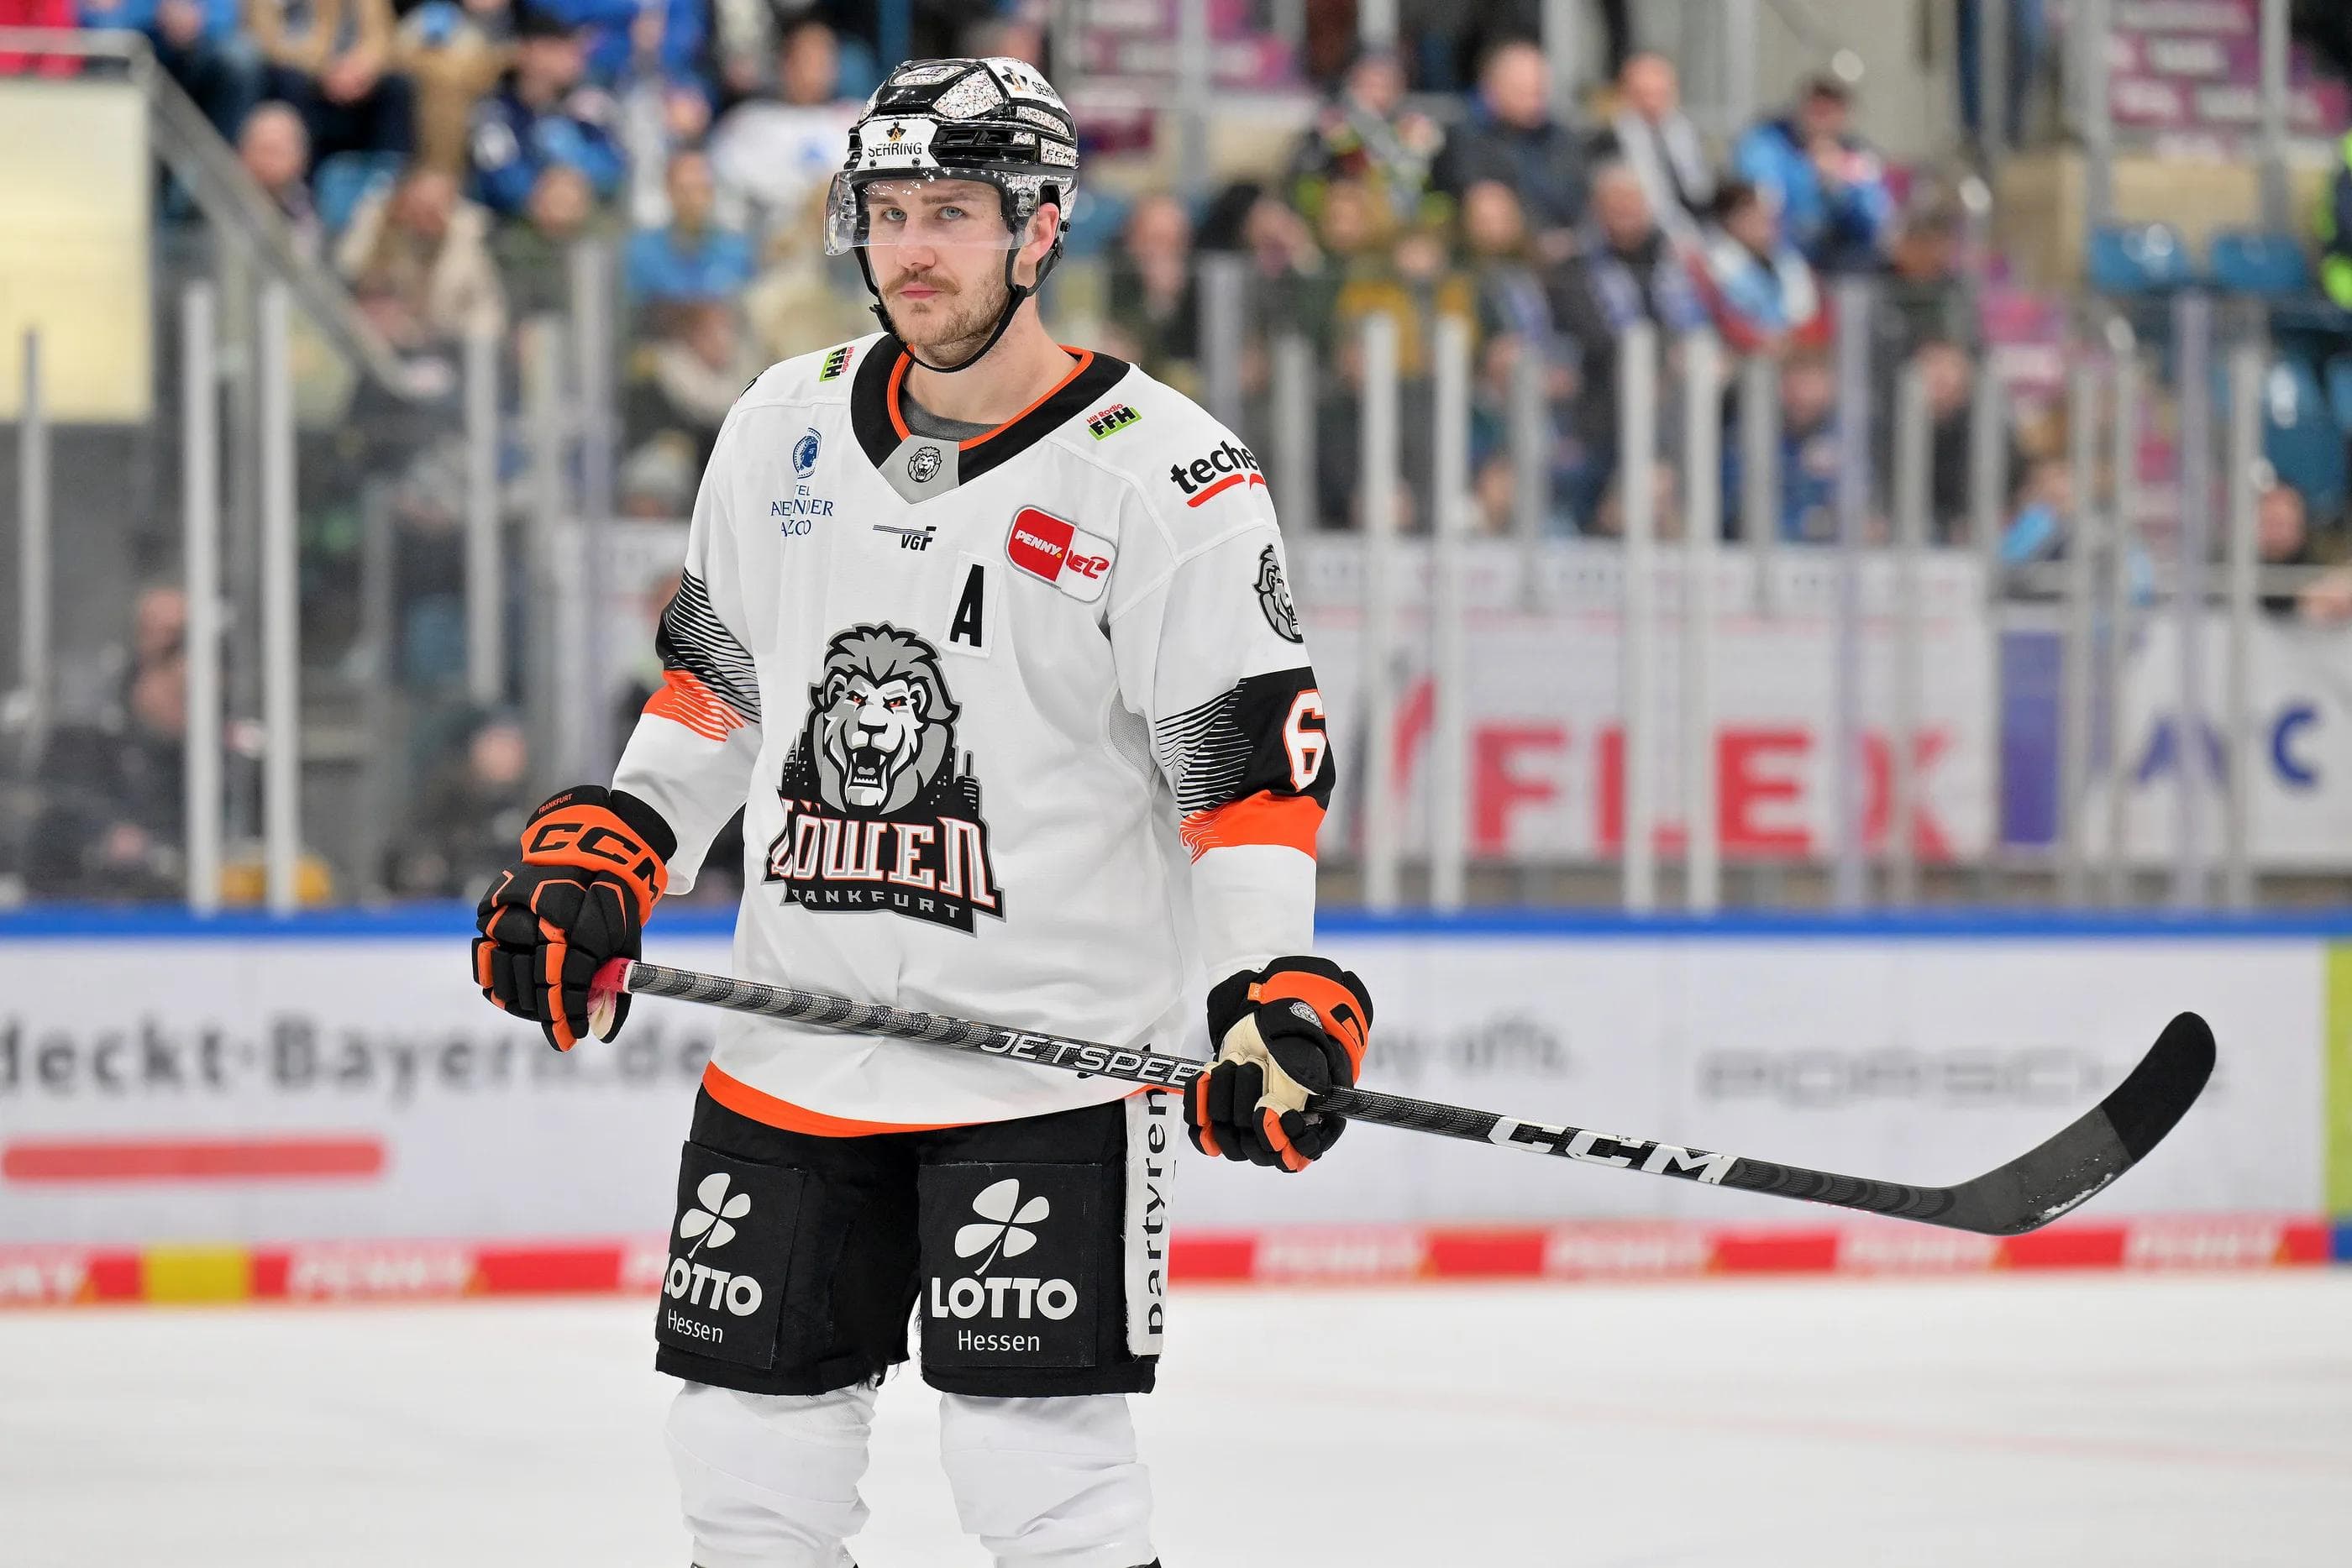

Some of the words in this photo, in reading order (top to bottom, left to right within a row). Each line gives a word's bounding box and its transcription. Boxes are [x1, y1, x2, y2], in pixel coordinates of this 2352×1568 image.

[868, 142, 922, 158] SEHRING
[1046, 149, 1072, 160] CCM
[824, 347, 848, 378] FFH
[1087, 414, 1099, 424] Hit
[1098, 404, 1123, 418] Radio
[1089, 406, 1137, 436] FFH
[1170, 440, 1259, 494] teche
[900, 526, 937, 552] VGF
[949, 564, 984, 648] A
[1283, 688, 1327, 793] 6
[538, 794, 573, 814] FRANKFURT
[529, 823, 660, 903] CCM
[980, 1031, 1204, 1086] JETSPEE
[1488, 1115, 1740, 1185] CCM
[1142, 1088, 1168, 1335] partyren
[932, 1277, 1078, 1320] LOTTO
[668, 1308, 723, 1344] Hessen
[958, 1329, 1040, 1351] Hessen
